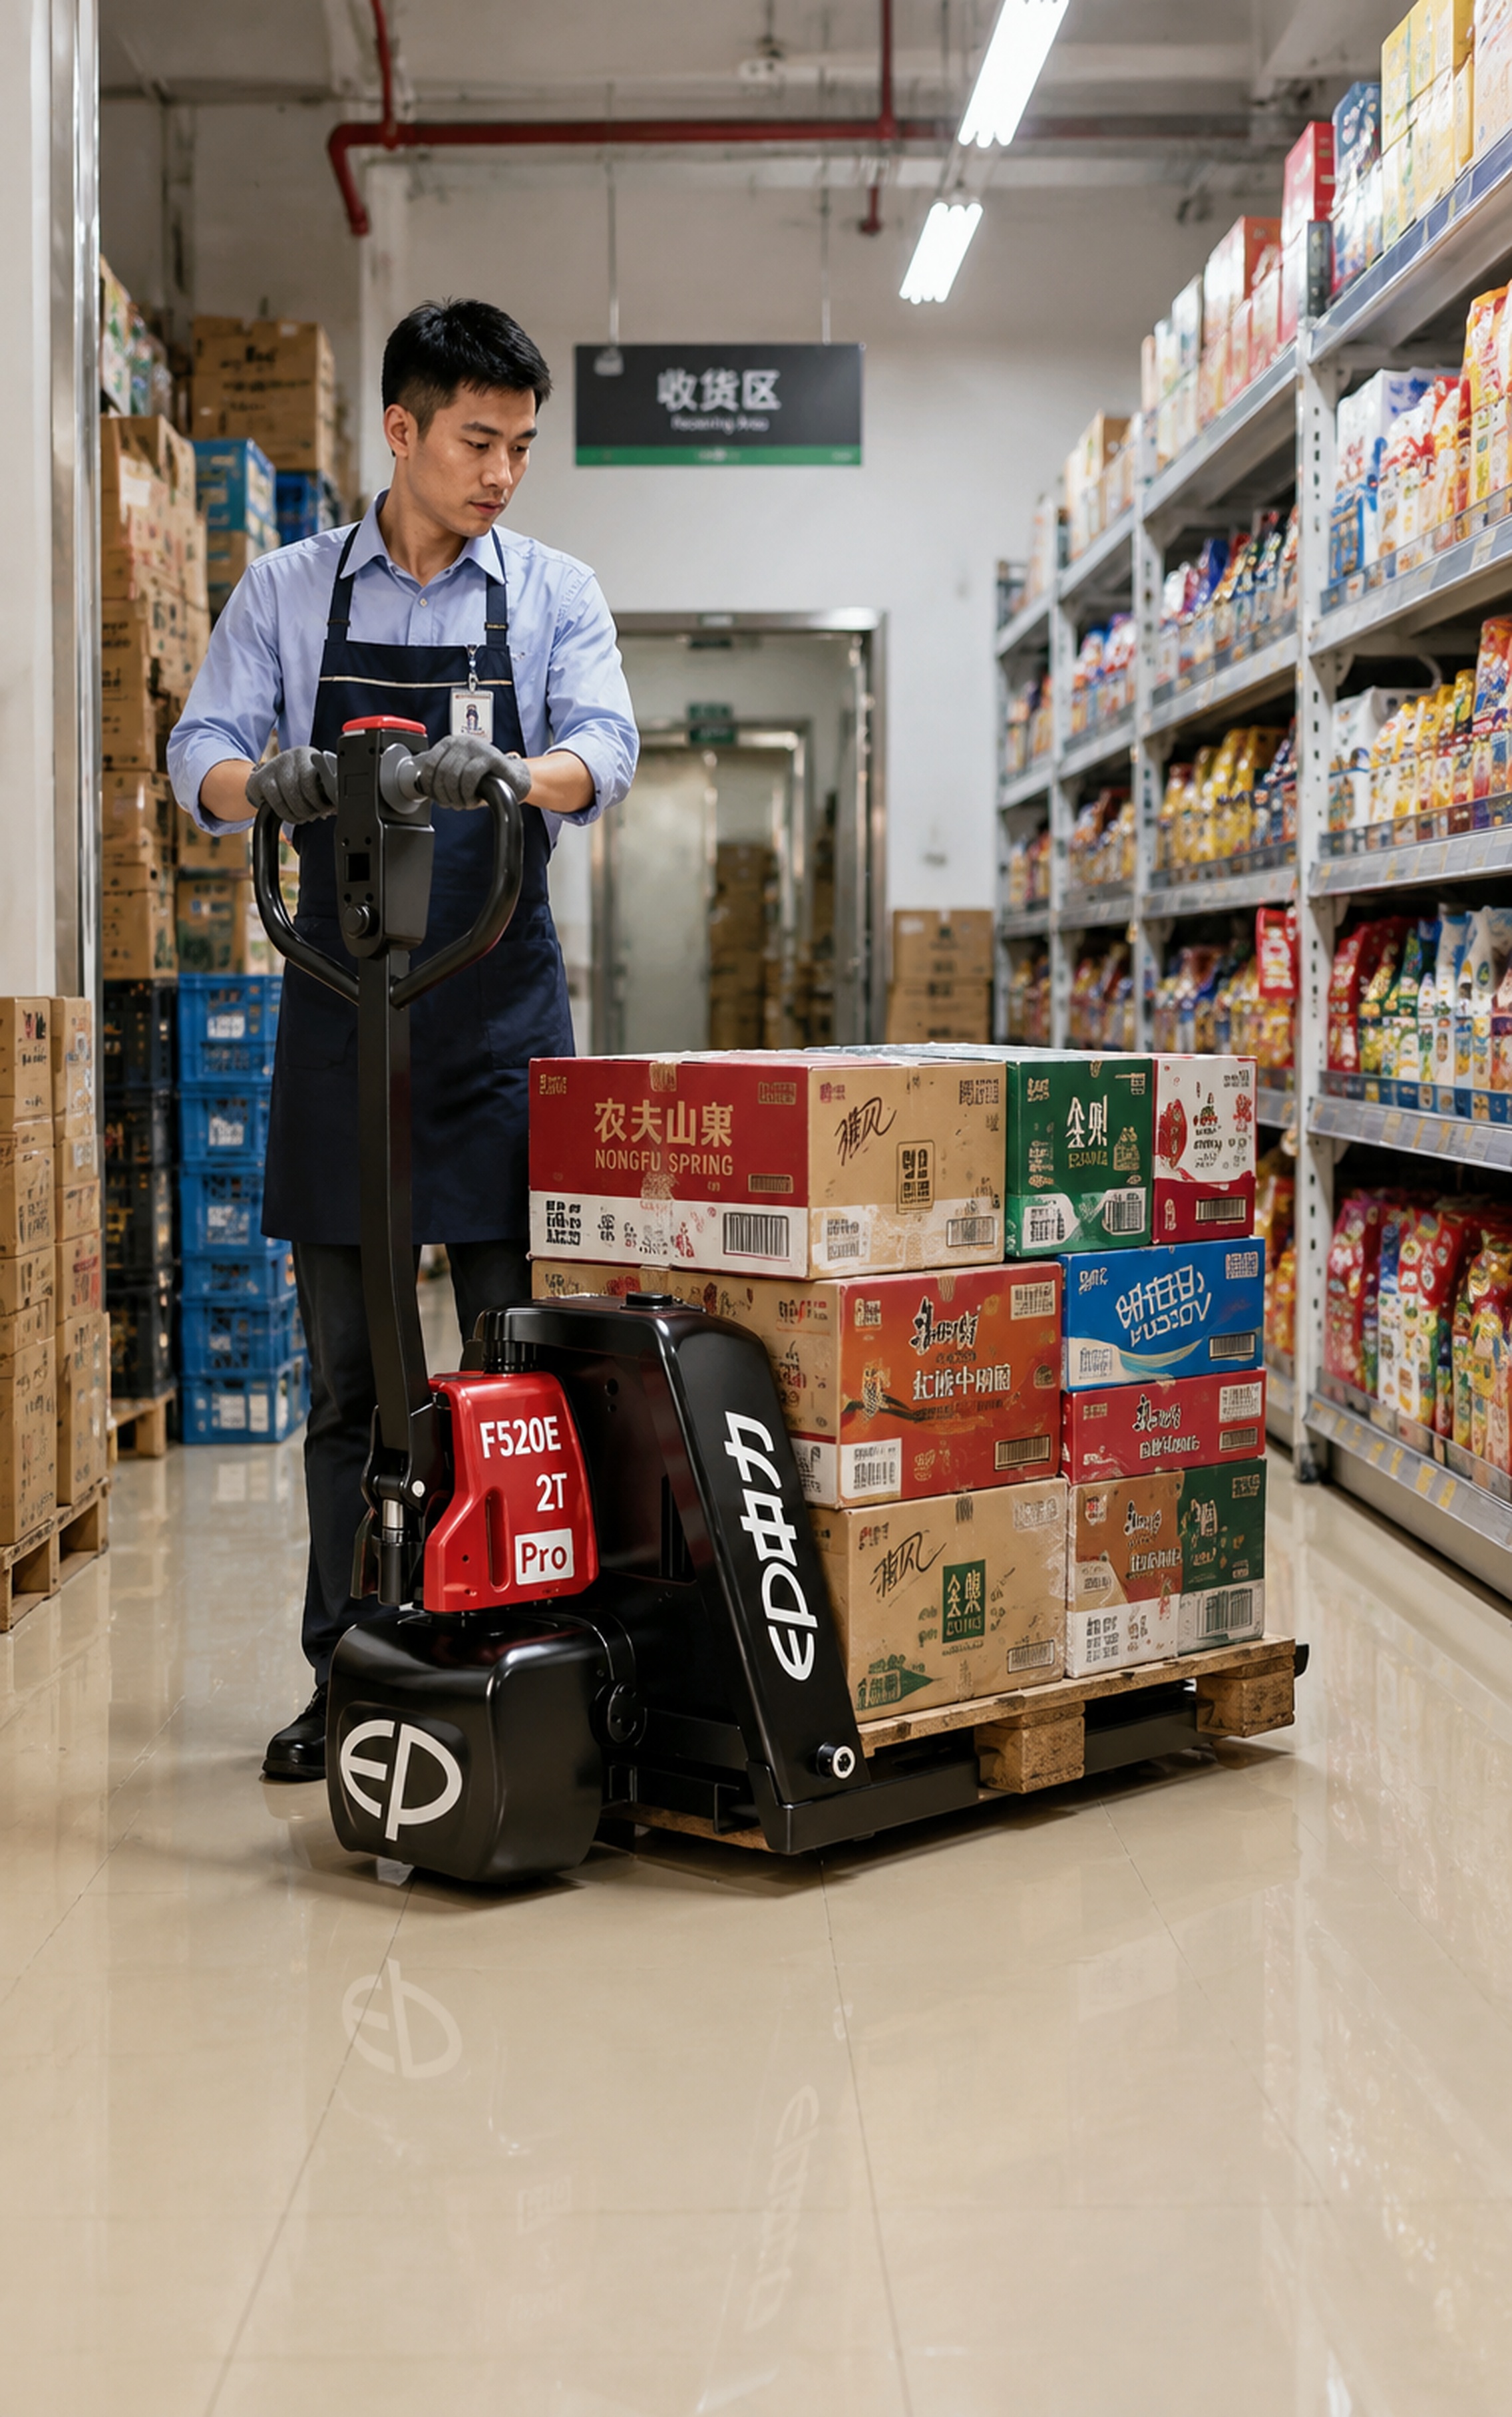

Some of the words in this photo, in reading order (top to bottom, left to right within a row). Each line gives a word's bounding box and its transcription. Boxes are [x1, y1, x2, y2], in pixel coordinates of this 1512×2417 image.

[657, 368, 781, 411] 收货区
[595, 1149, 661, 1171] NONGFU
[668, 1153, 733, 1176] SPRING
[480, 1415, 561, 1459] F520E
[536, 1472, 567, 1512] 2T
[521, 1542, 566, 1574] Pro
[340, 1719, 463, 1841] EP
